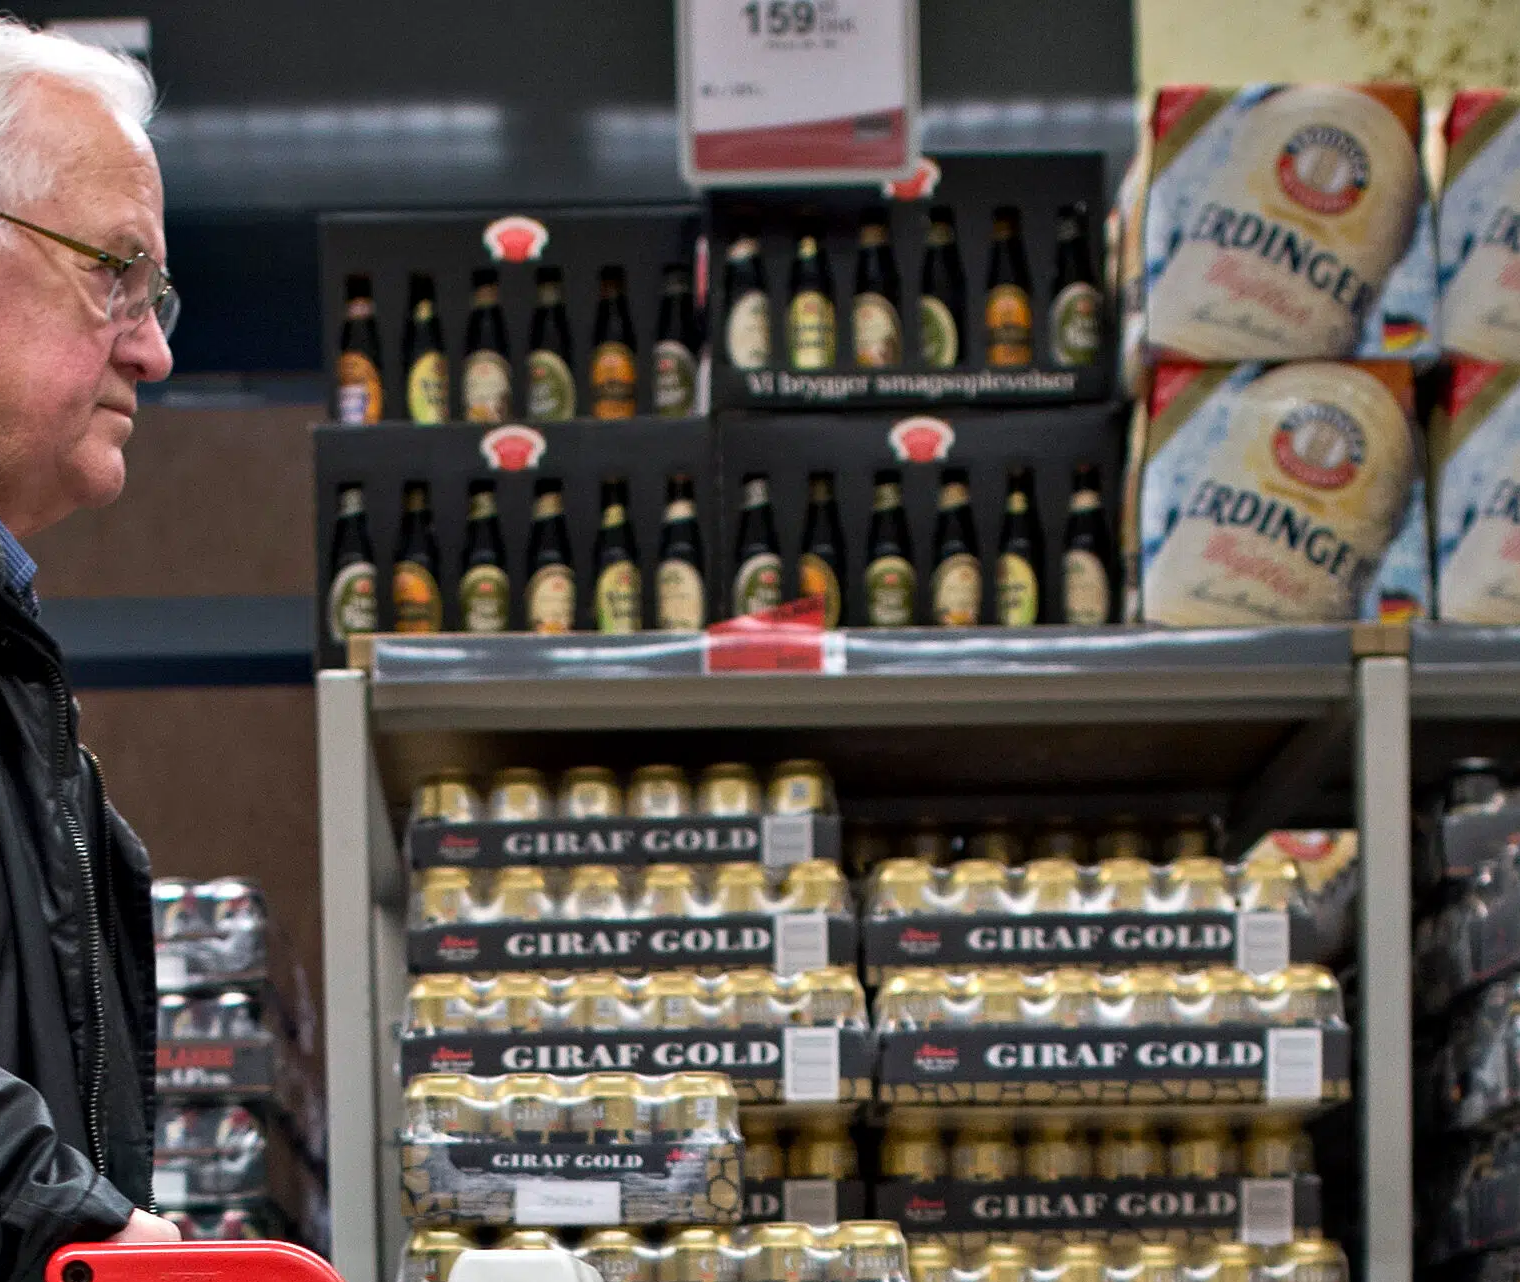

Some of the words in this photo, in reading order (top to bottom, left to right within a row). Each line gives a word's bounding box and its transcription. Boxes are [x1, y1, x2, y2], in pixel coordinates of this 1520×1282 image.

[502, 831, 633, 856] GIRAF
[640, 826, 759, 852] GOLD
[504, 930, 643, 957] GIRAF
[650, 927, 771, 953] GOLD
[967, 926, 1103, 952] GIRAF
[1109, 924, 1232, 950] GOLD
[501, 1044, 644, 1071] GIRAF
[652, 1040, 780, 1067] GOLD
[986, 1042, 1128, 1068] GIRAF
[1135, 1041, 1263, 1067] GOLD
[492, 1153, 571, 1170] GIRAF
[574, 1152, 644, 1170] GOLD
[972, 1194, 1109, 1219] GIRAF
[1117, 1191, 1237, 1217] GOLD
